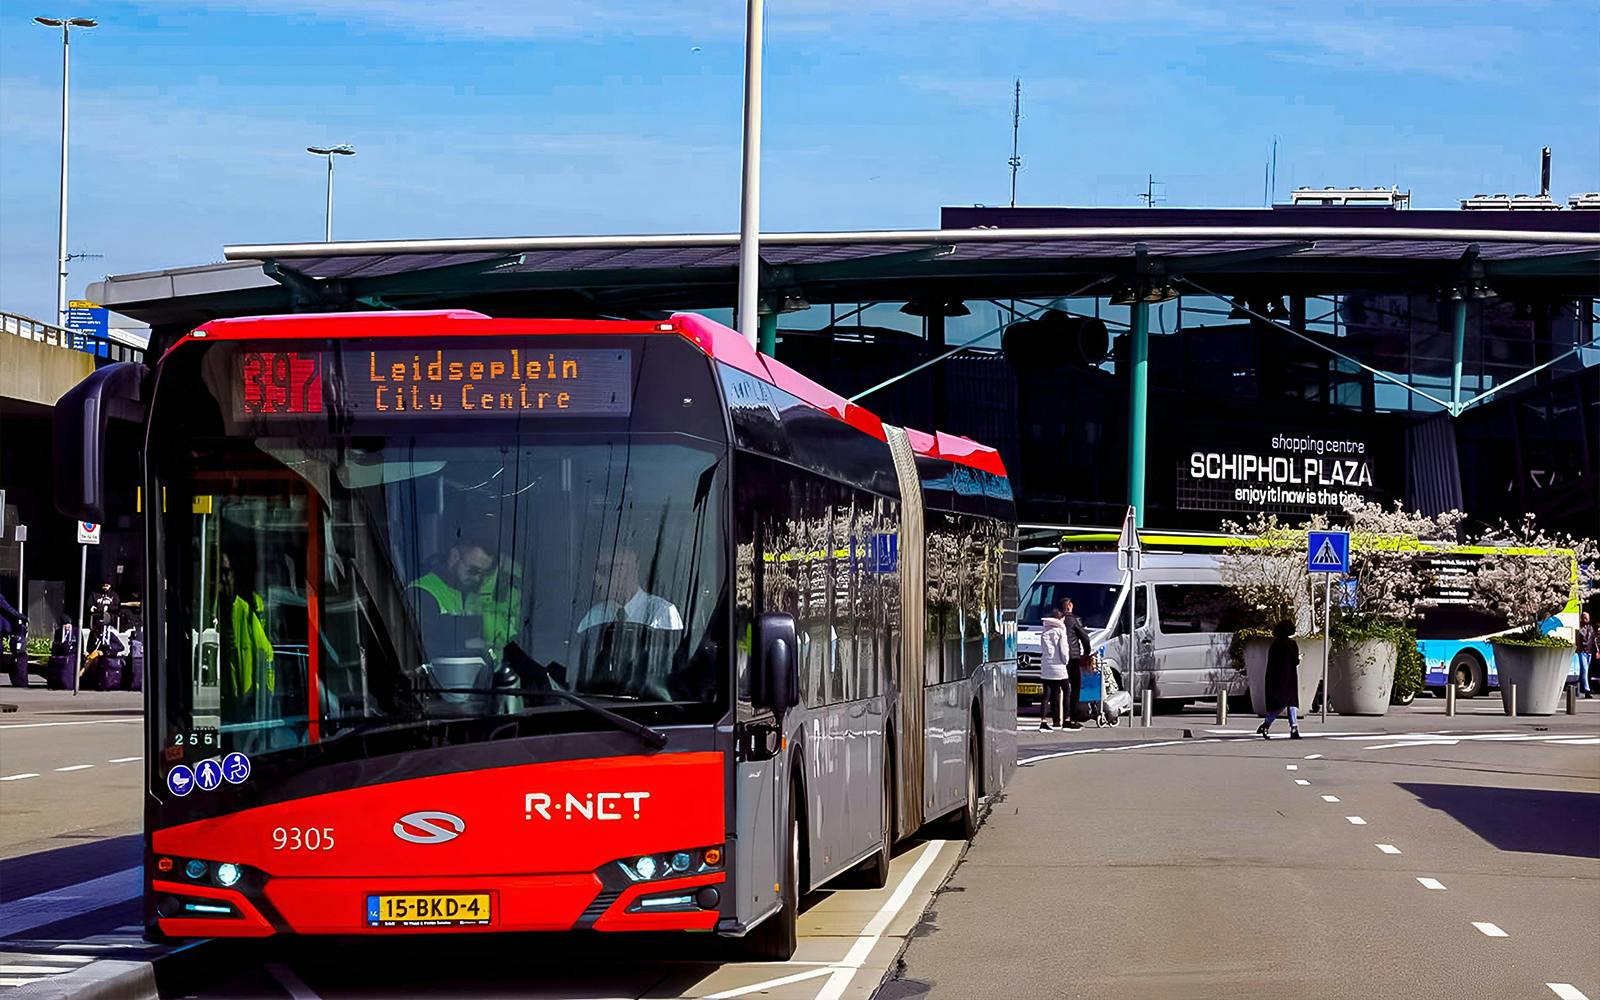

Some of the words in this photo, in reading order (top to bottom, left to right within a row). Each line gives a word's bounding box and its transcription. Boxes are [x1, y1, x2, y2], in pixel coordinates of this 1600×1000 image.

[241, 351, 322, 414] 397
[369, 350, 578, 382] Leidseplein
[375, 386, 443, 411] City
[461, 384, 571, 410] Centre
[1271, 433, 1324, 455] shopping
[1325, 439, 1365, 454] centre
[1190, 451, 1302, 484] SCHIPHOL
[1304, 457, 1373, 487] PLAZA
[1234, 485, 1266, 505] enjoy
[1281, 490, 1306, 504] now
[1306, 487, 1317, 504] is
[1317, 488, 1338, 506] the
[272, 826, 335, 850] 9305
[386, 898, 480, 917] 15-BKD-4
